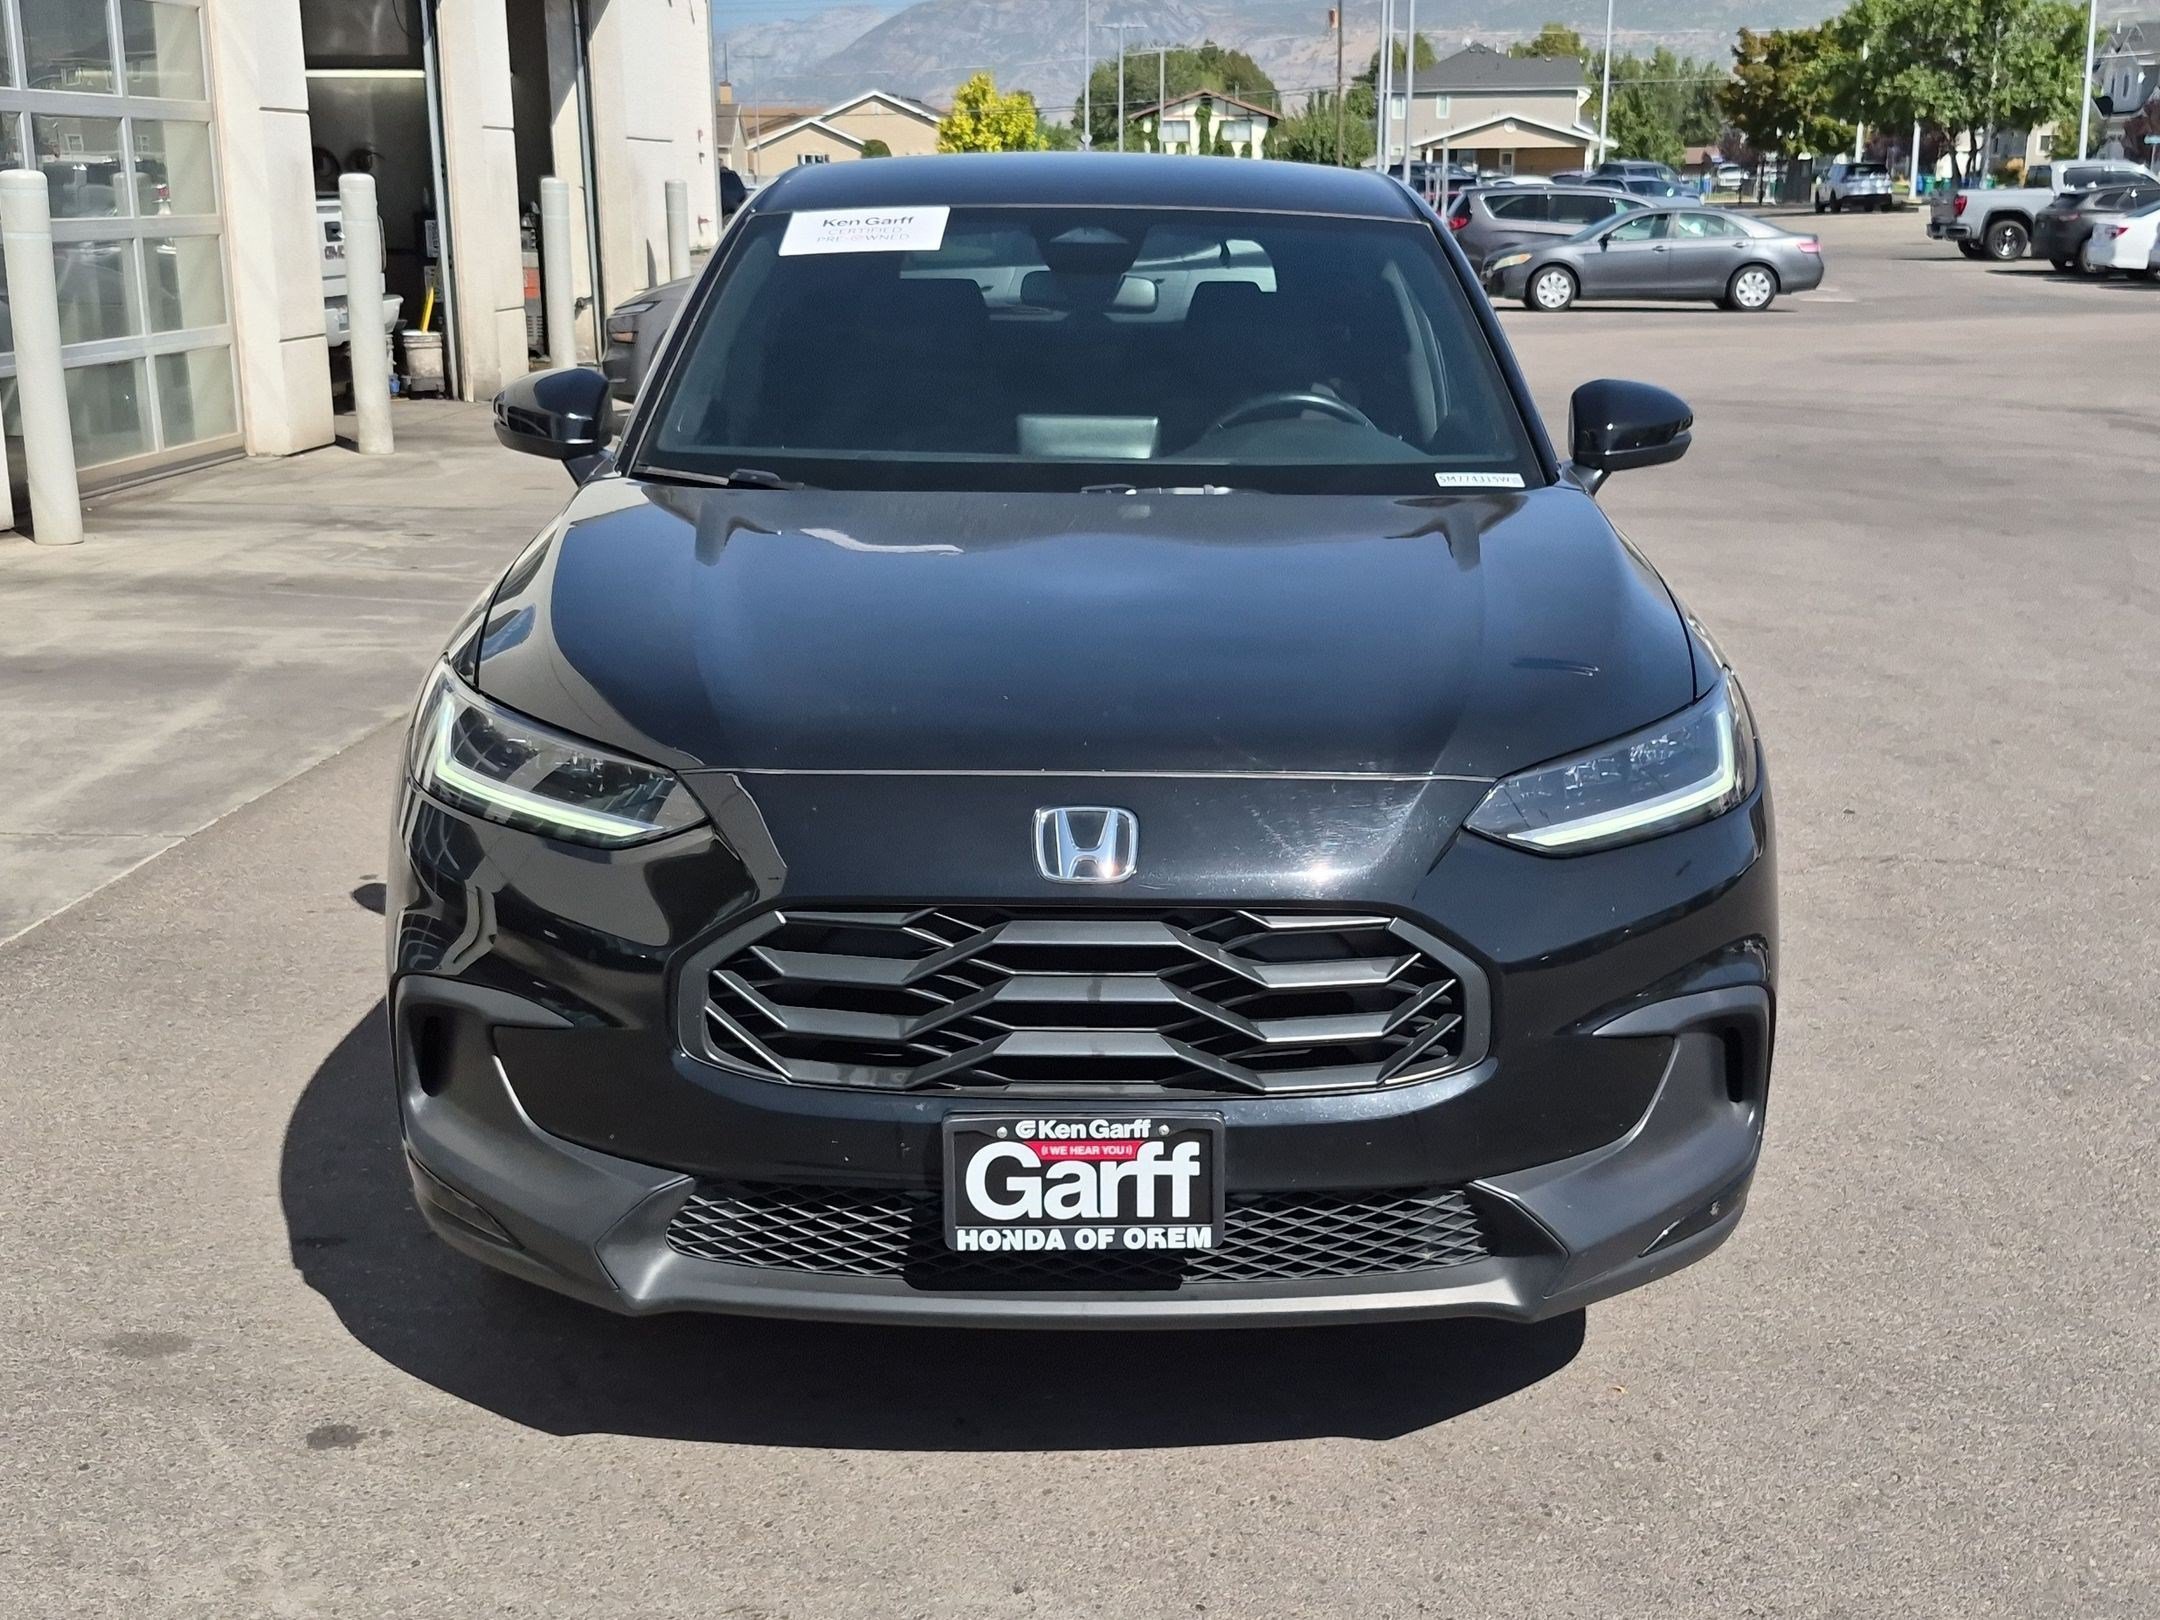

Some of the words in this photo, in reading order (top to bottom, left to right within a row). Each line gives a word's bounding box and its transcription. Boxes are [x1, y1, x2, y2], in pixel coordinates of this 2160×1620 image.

[822, 219, 861, 227] Ken
[865, 216, 914, 226] Garff
[1038, 1119, 1087, 1139] Ken
[1088, 1119, 1151, 1139] Garff
[1049, 1145, 1069, 1156] WE
[1070, 1145, 1101, 1156] HEAR
[1101, 1145, 1126, 1156] YOU
[965, 1140, 1200, 1221] Garff
[956, 1228, 1067, 1252] HONDA
[1074, 1228, 1116, 1250] OF
[1123, 1226, 1212, 1250] OREM
